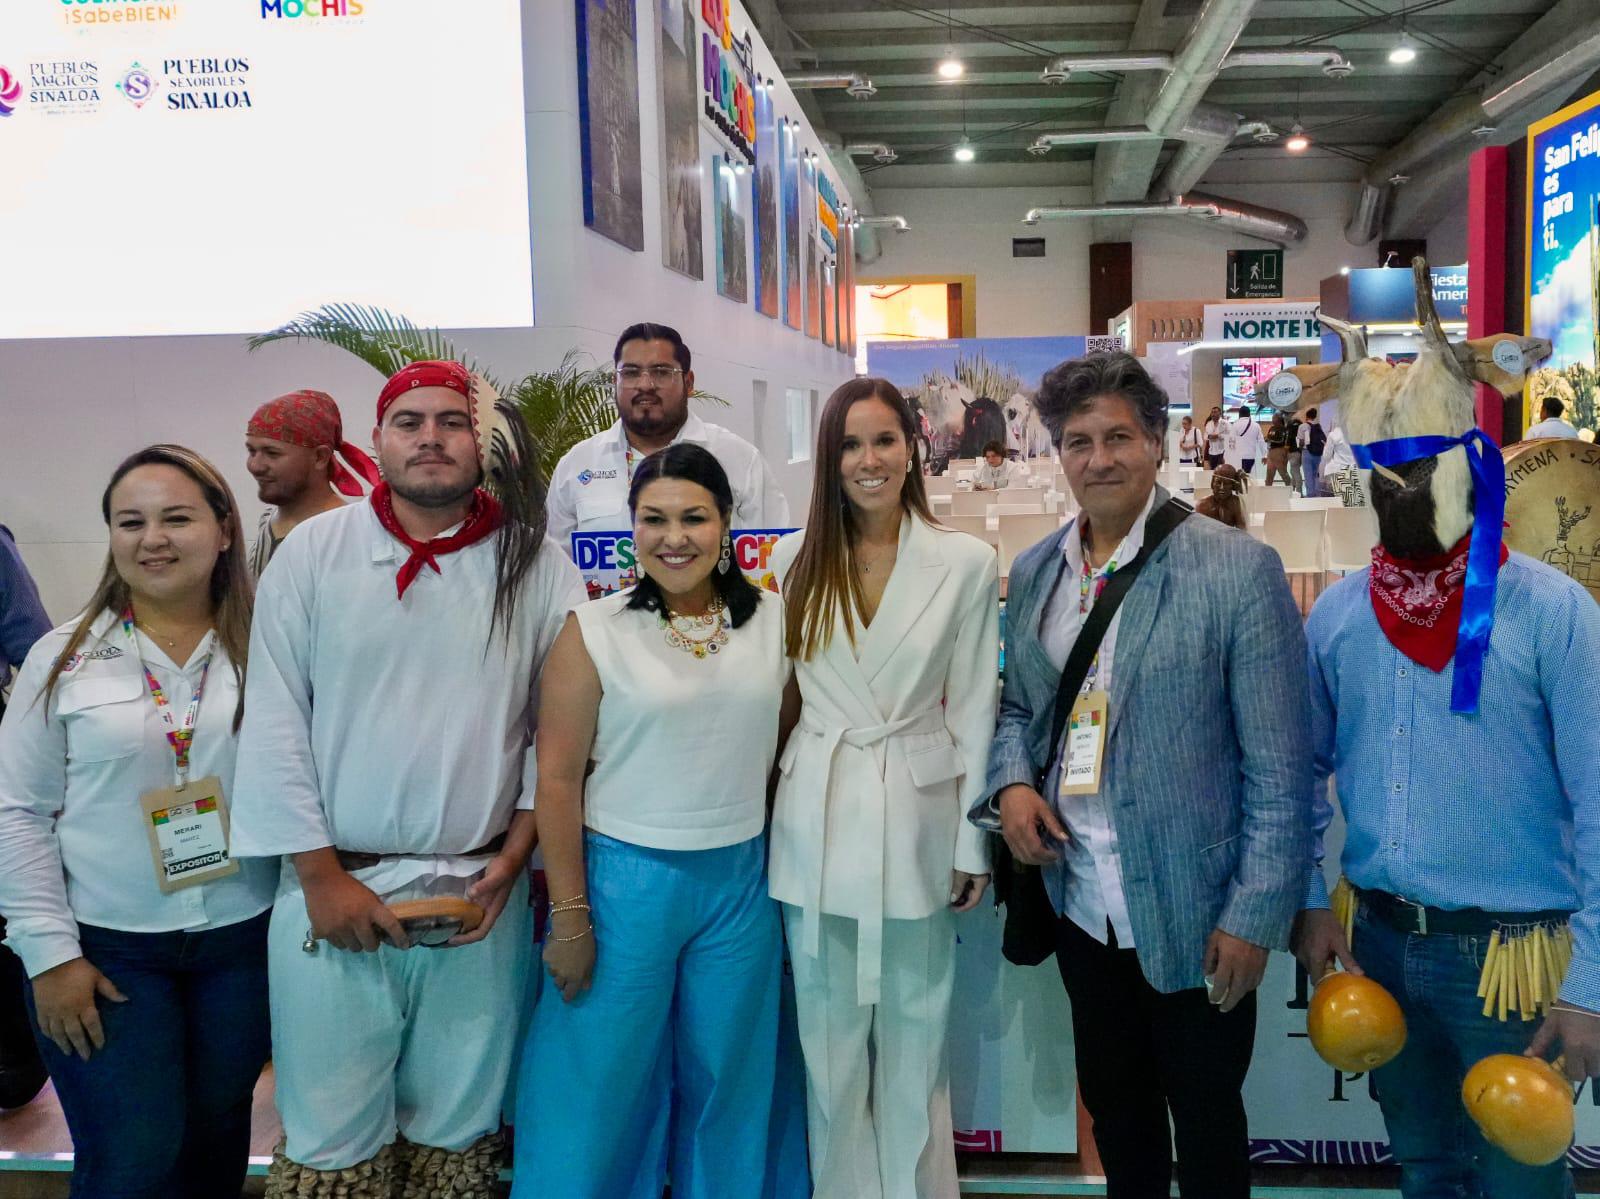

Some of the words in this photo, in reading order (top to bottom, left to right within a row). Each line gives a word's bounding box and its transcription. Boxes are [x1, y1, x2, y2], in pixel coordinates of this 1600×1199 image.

[260, 0, 364, 19] MOCHIS
[30, 61, 98, 75] PUEBLOS
[163, 57, 250, 75] PUEBLOS
[30, 89, 100, 103] SINALOA
[166, 90, 252, 111] SINALOA
[1544, 145, 1570, 173] San
[1543, 172, 1560, 197] es
[1543, 191, 1574, 227] para
[1543, 222, 1560, 251] ti.
[1249, 283, 1268, 291] Salida
[1223, 319, 1301, 339] NORTE
[169, 854, 221, 873] EXPOSITOR
